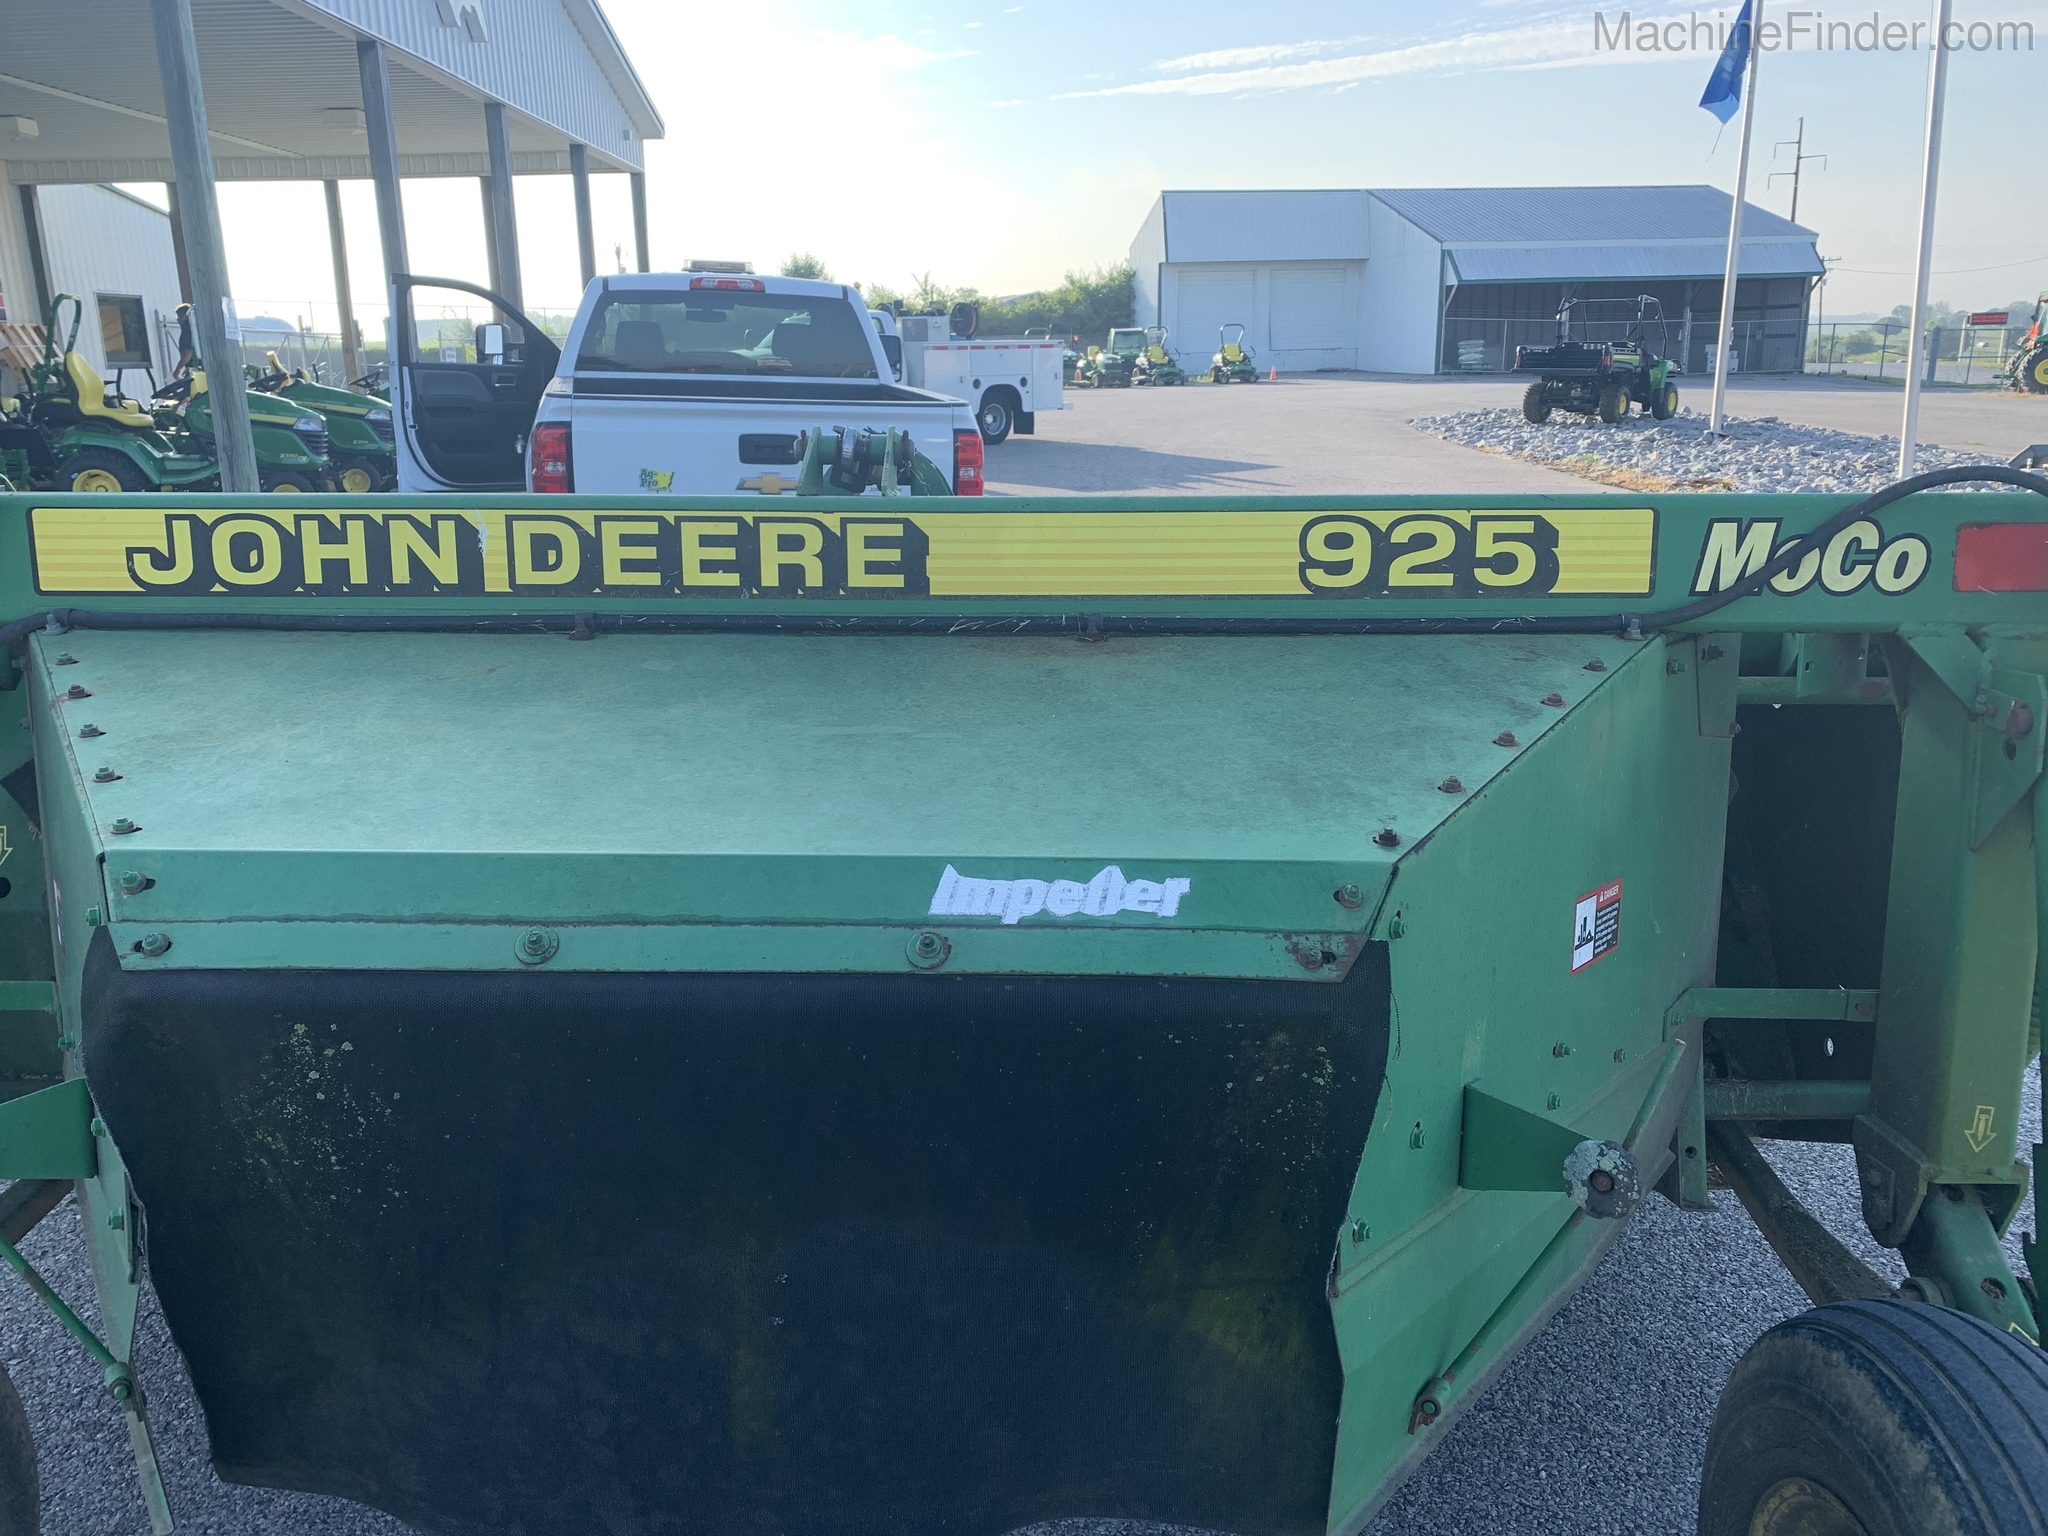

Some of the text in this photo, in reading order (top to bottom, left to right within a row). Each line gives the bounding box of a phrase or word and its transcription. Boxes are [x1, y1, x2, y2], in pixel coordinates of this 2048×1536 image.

[640, 478, 658, 488] Pro
[128, 515, 1548, 592] JOHN DEERE 925
[1690, 517, 1931, 596] MoCo
[928, 864, 1191, 924] Impeller
